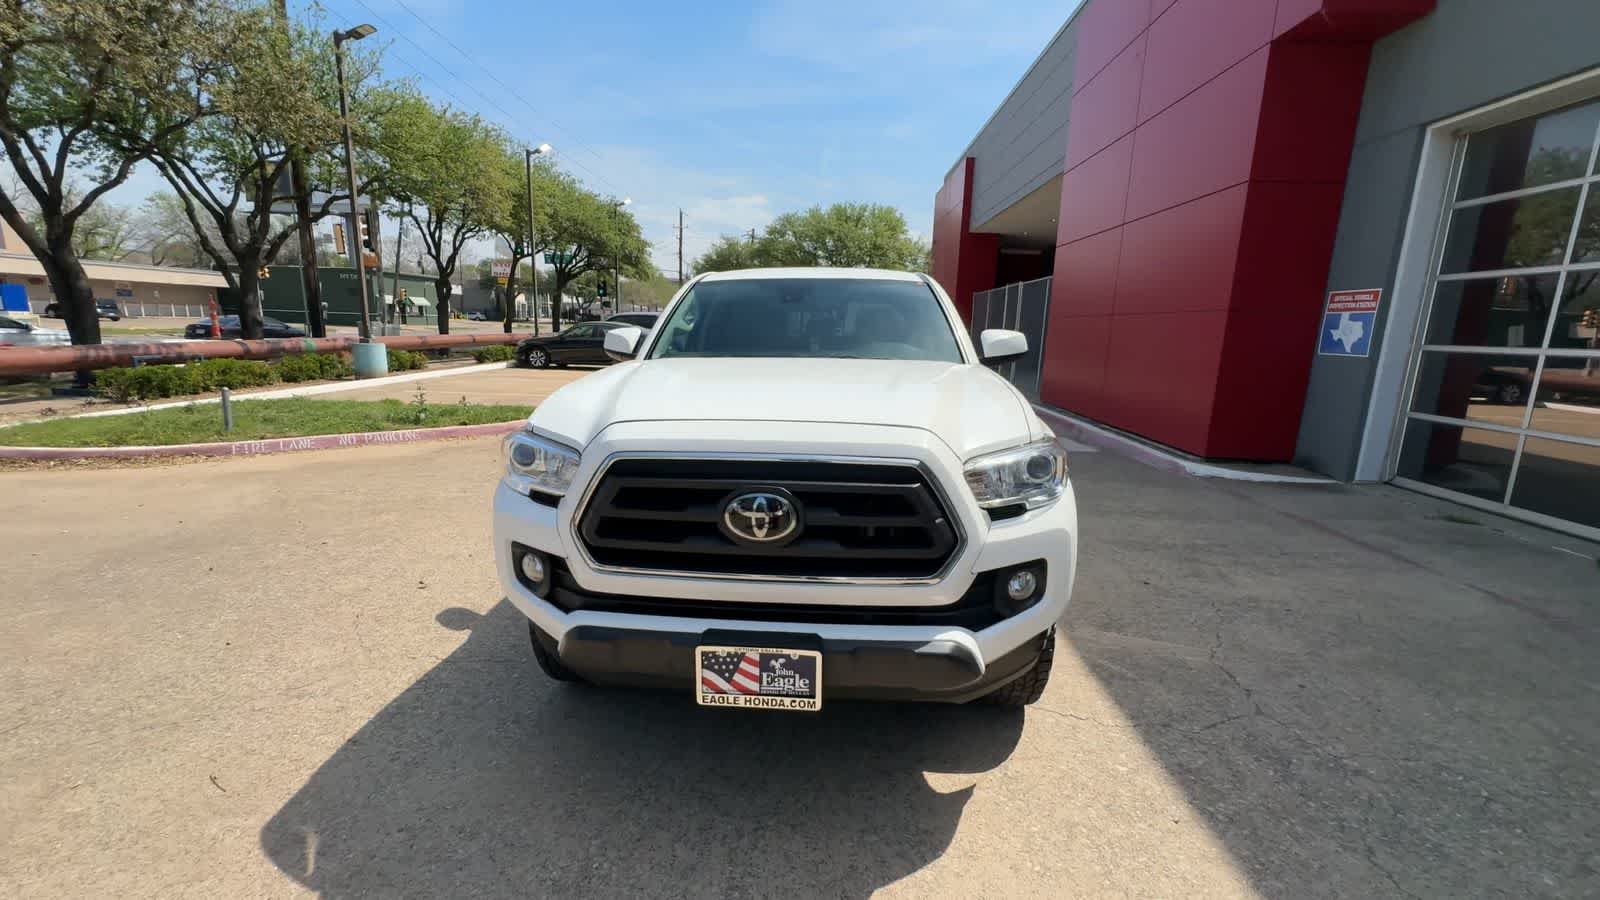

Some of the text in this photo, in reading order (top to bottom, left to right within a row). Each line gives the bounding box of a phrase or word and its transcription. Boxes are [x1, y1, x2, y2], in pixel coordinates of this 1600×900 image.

[280, 439, 315, 451] LANE
[775, 667, 794, 676] John
[761, 672, 810, 690] Eagle
[702, 695, 816, 709] EAGLE HONDA.COM
